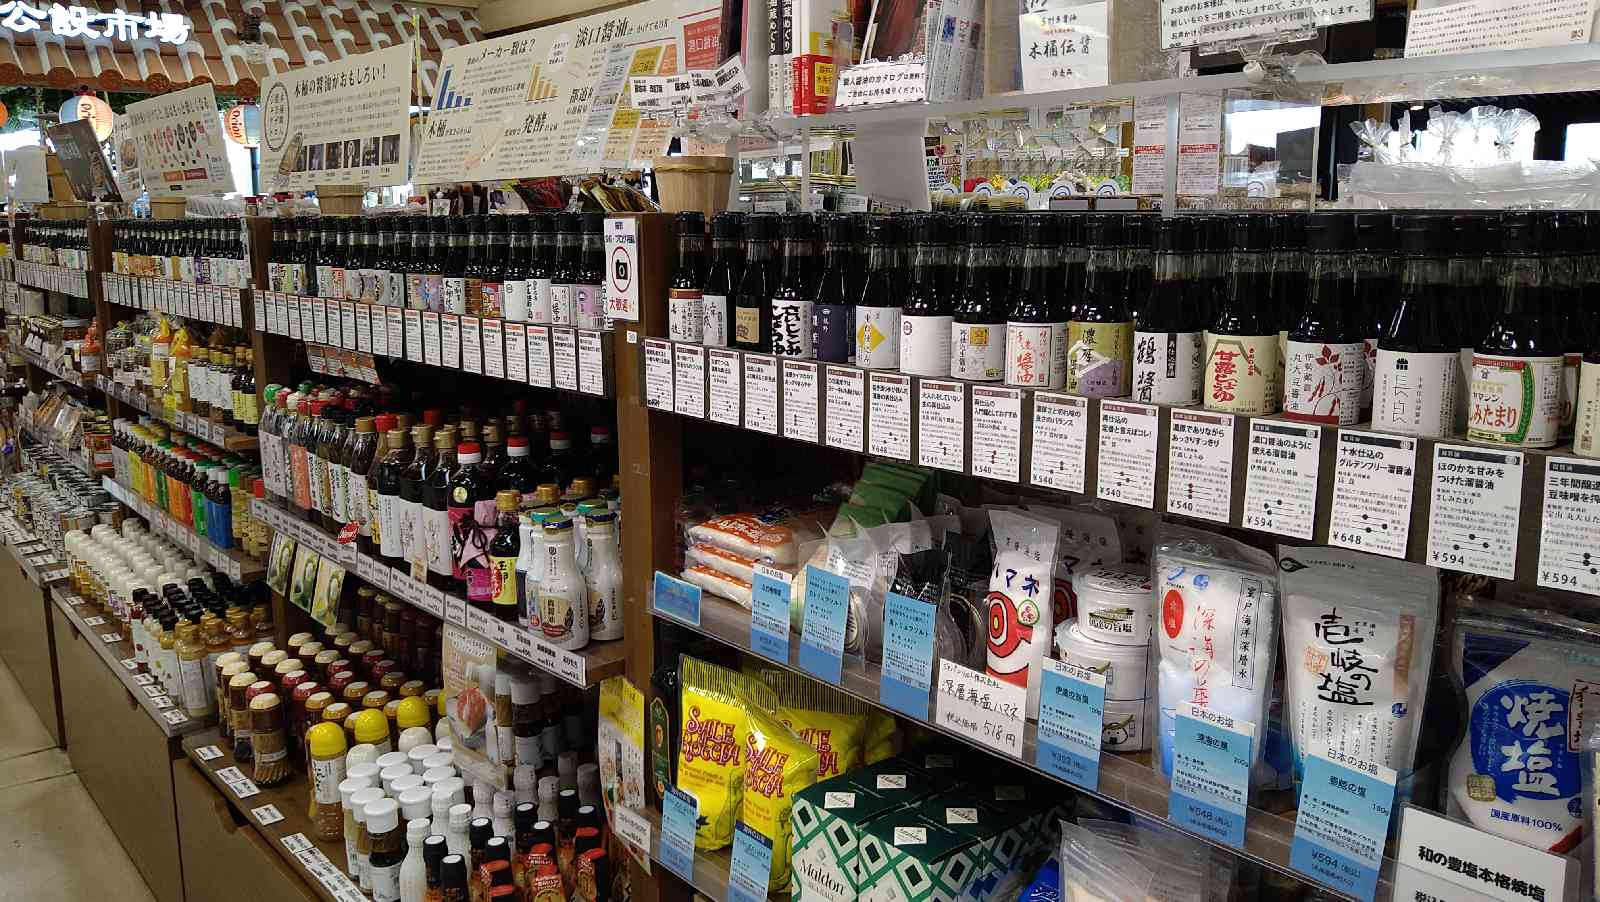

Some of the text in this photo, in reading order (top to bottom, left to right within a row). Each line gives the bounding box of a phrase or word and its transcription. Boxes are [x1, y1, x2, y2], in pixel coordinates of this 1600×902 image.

[0, 2, 190, 46] 公設市場
[231, 110, 243, 139] Orion
[1212, 350, 1240, 403] 甘露しょうゆ
[1172, 423, 1226, 438] 濃厚でありながら
[1171, 434, 1221, 448] あっさりすっきり
[1252, 435, 1313, 451] 濃口醤油のように
[1252, 446, 1297, 461] 使える溜醤油
[1340, 447, 1385, 461] 十水仕込の
[974, 464, 993, 475] ¥540
[1339, 457, 1412, 477] グルテンフリー溜醤油
[1437, 462, 1506, 479] ほのかな甘みを
[1033, 473, 1054, 486] ¥540
[1437, 474, 1495, 491] つけた溜醤油
[1099, 487, 1121, 498] ¥540
[1169, 500, 1193, 512] ¥540
[1246, 515, 1274, 529] ¥594
[1332, 530, 1362, 546] ¥648
[1431, 550, 1466, 566] ¥594
[1541, 570, 1578, 587] ¥594
[685, 704, 736, 744] SALE
[1191, 706, 1234, 729] 日本のお塩
[1500, 690, 1566, 797] 焼塩
[1327, 747, 1379, 776] 日本のお塩
[1489, 807, 1564, 834] 国産原料100%
[799, 858, 845, 897] Maldon
[1417, 844, 1547, 902] 和の豊塩本格焼塩
